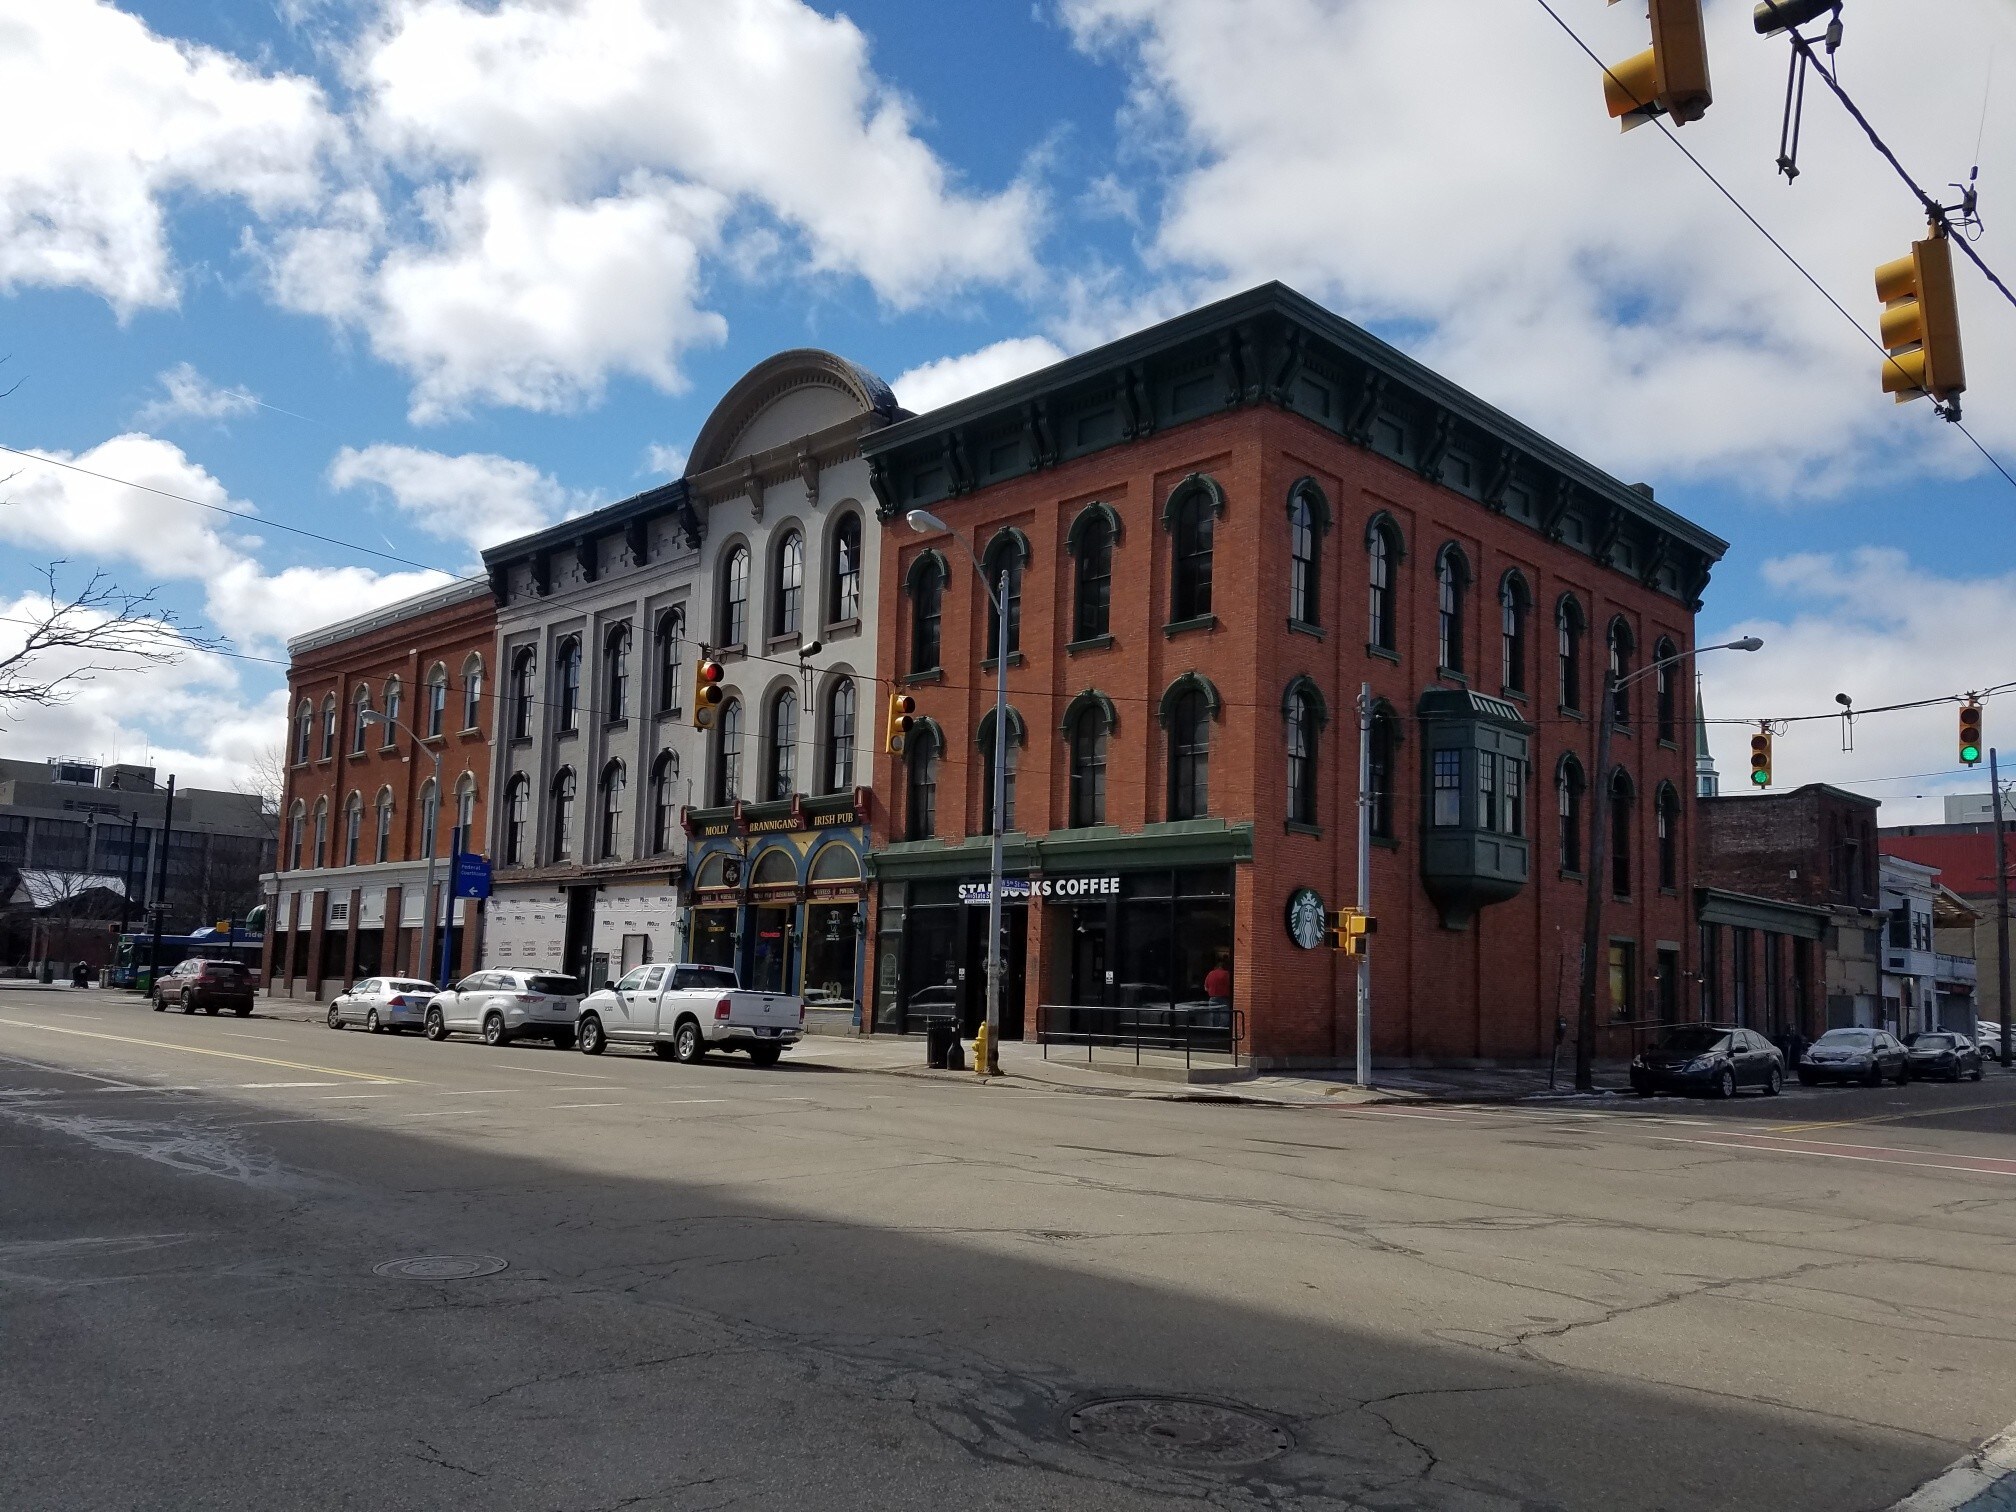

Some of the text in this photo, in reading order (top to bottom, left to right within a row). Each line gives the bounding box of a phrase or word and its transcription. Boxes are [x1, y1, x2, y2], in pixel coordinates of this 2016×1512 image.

[705, 812, 854, 836] MOLLY BRANNIGANS IRISH PUB
[972, 891, 986, 900] State
[1055, 878, 1120, 896] COFFEE
